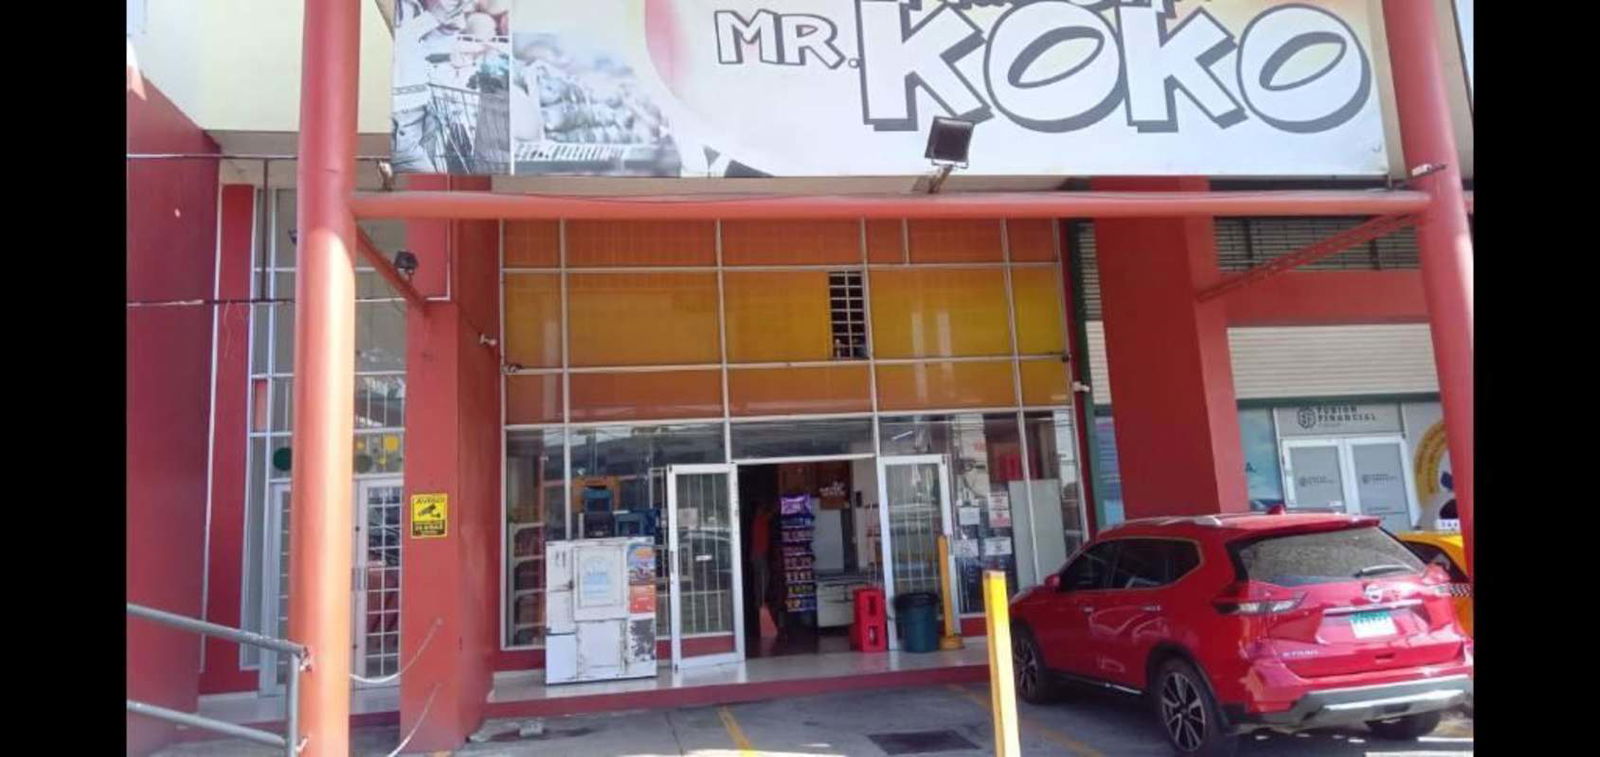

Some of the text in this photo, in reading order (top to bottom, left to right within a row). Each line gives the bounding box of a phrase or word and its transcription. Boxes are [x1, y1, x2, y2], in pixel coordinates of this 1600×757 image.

[714, 0, 1372, 133] MR. KOKO
[1318, 413, 1376, 422] FINANCIAL
